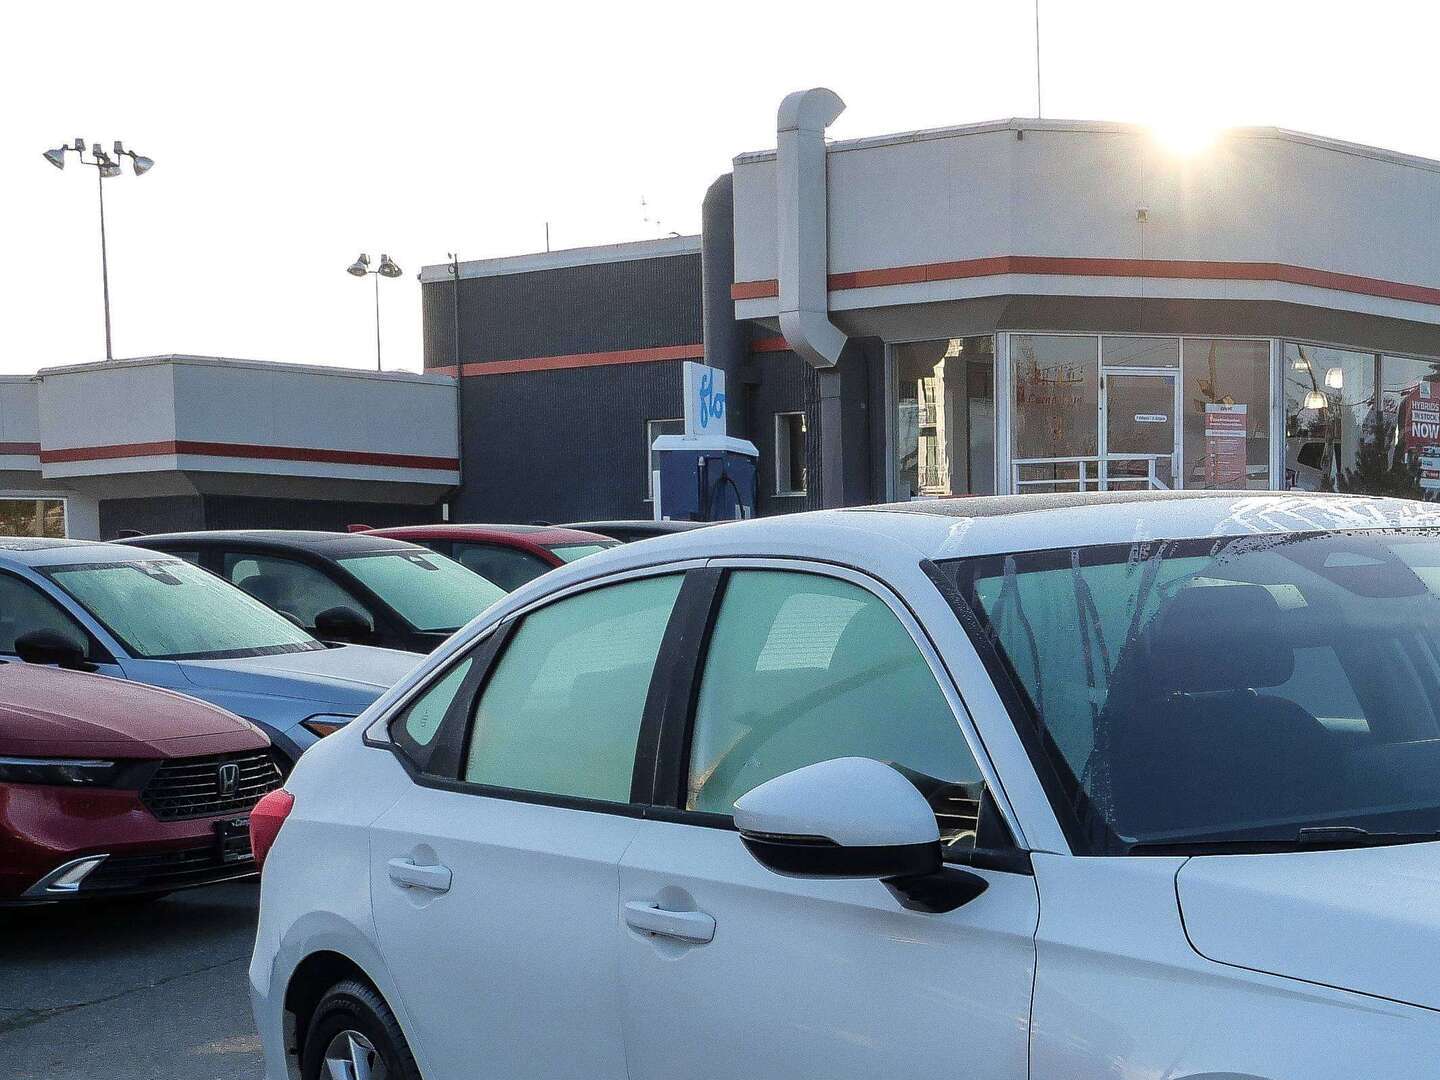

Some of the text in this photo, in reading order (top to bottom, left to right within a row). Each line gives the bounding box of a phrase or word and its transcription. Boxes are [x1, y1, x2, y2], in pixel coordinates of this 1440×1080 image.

[699, 368, 726, 428] flo
[1412, 401, 1440, 411] HYBRIDS
[1412, 422, 1440, 439] NOW
